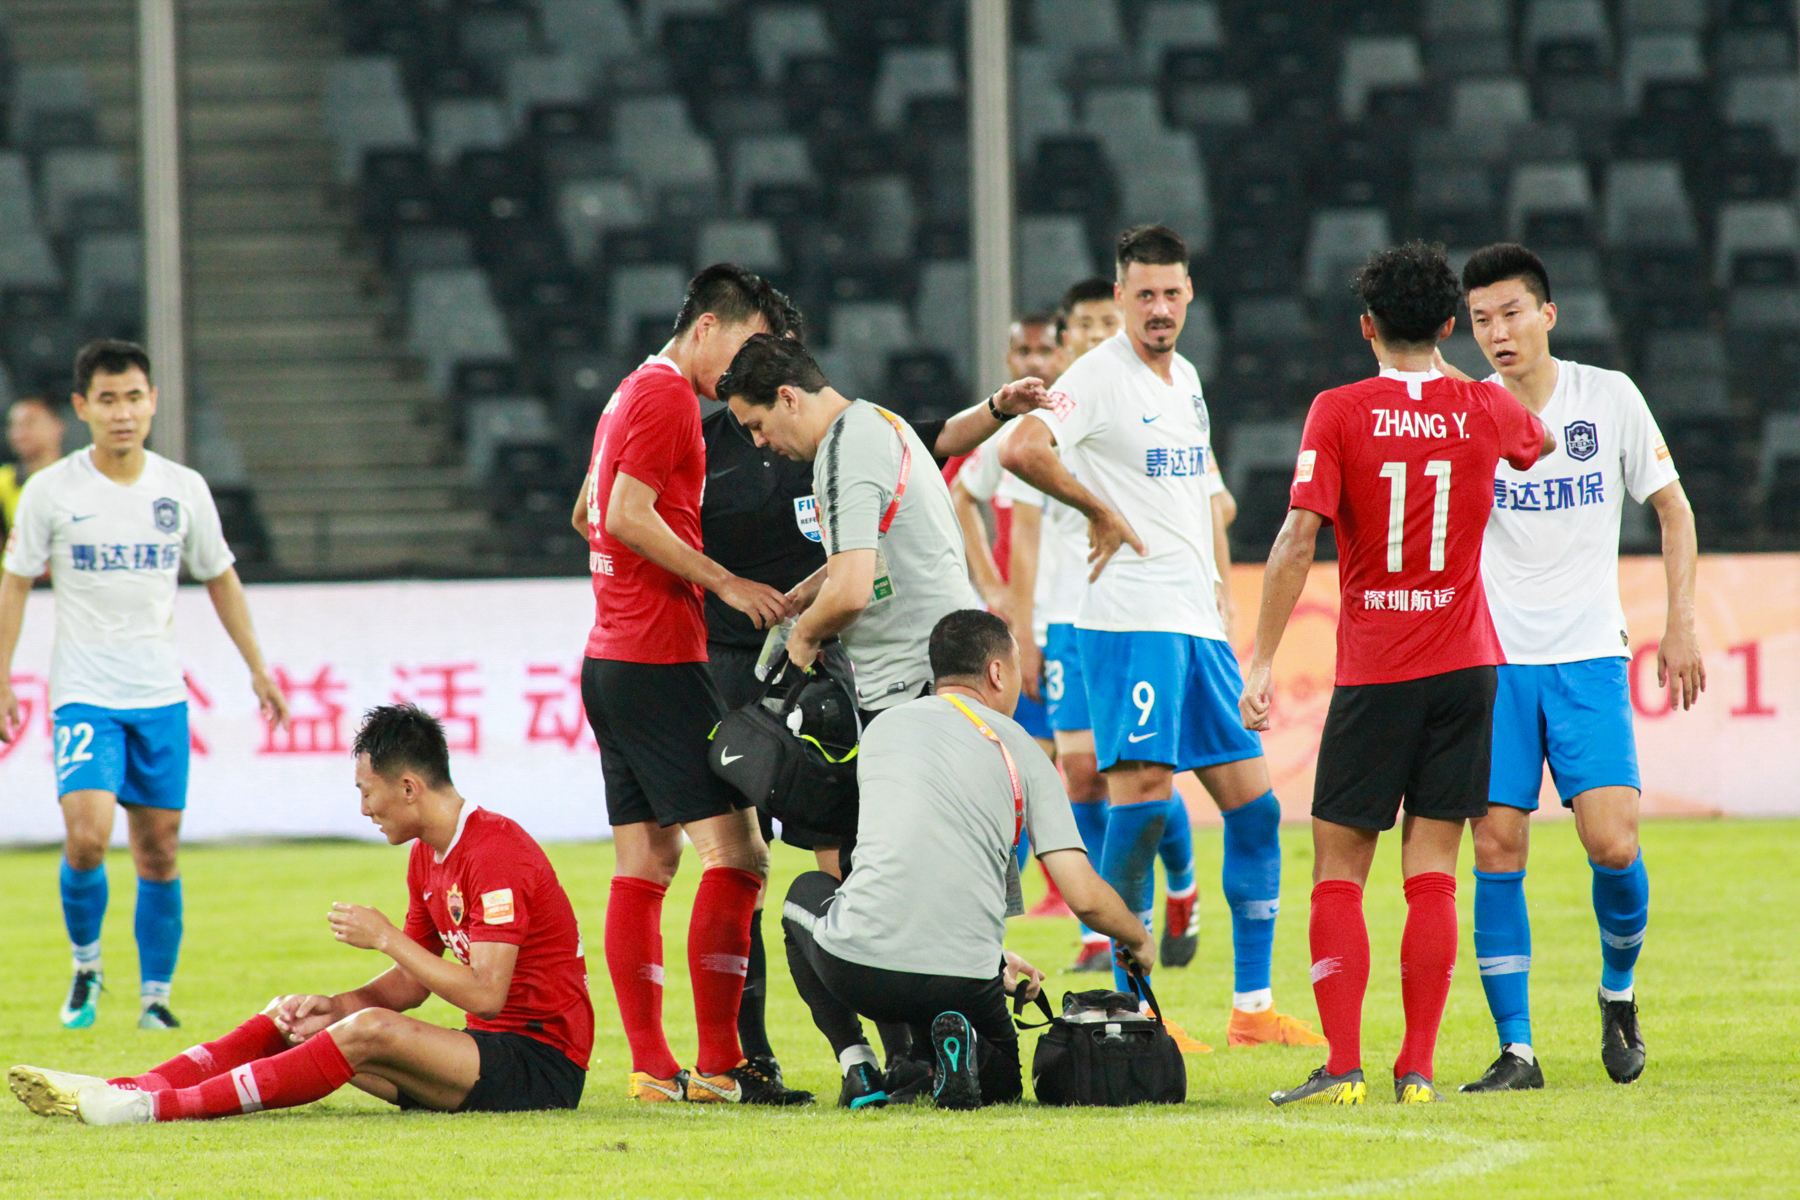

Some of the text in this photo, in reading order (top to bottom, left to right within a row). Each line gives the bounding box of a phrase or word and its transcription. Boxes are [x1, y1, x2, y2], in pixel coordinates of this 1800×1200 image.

[1372, 409, 1470, 438] ZHANG Y.
[1378, 460, 1452, 573] 11
[1363, 587, 1456, 612] 深圳航运
[1132, 681, 1156, 727] 9
[56, 722, 95, 766] 22
